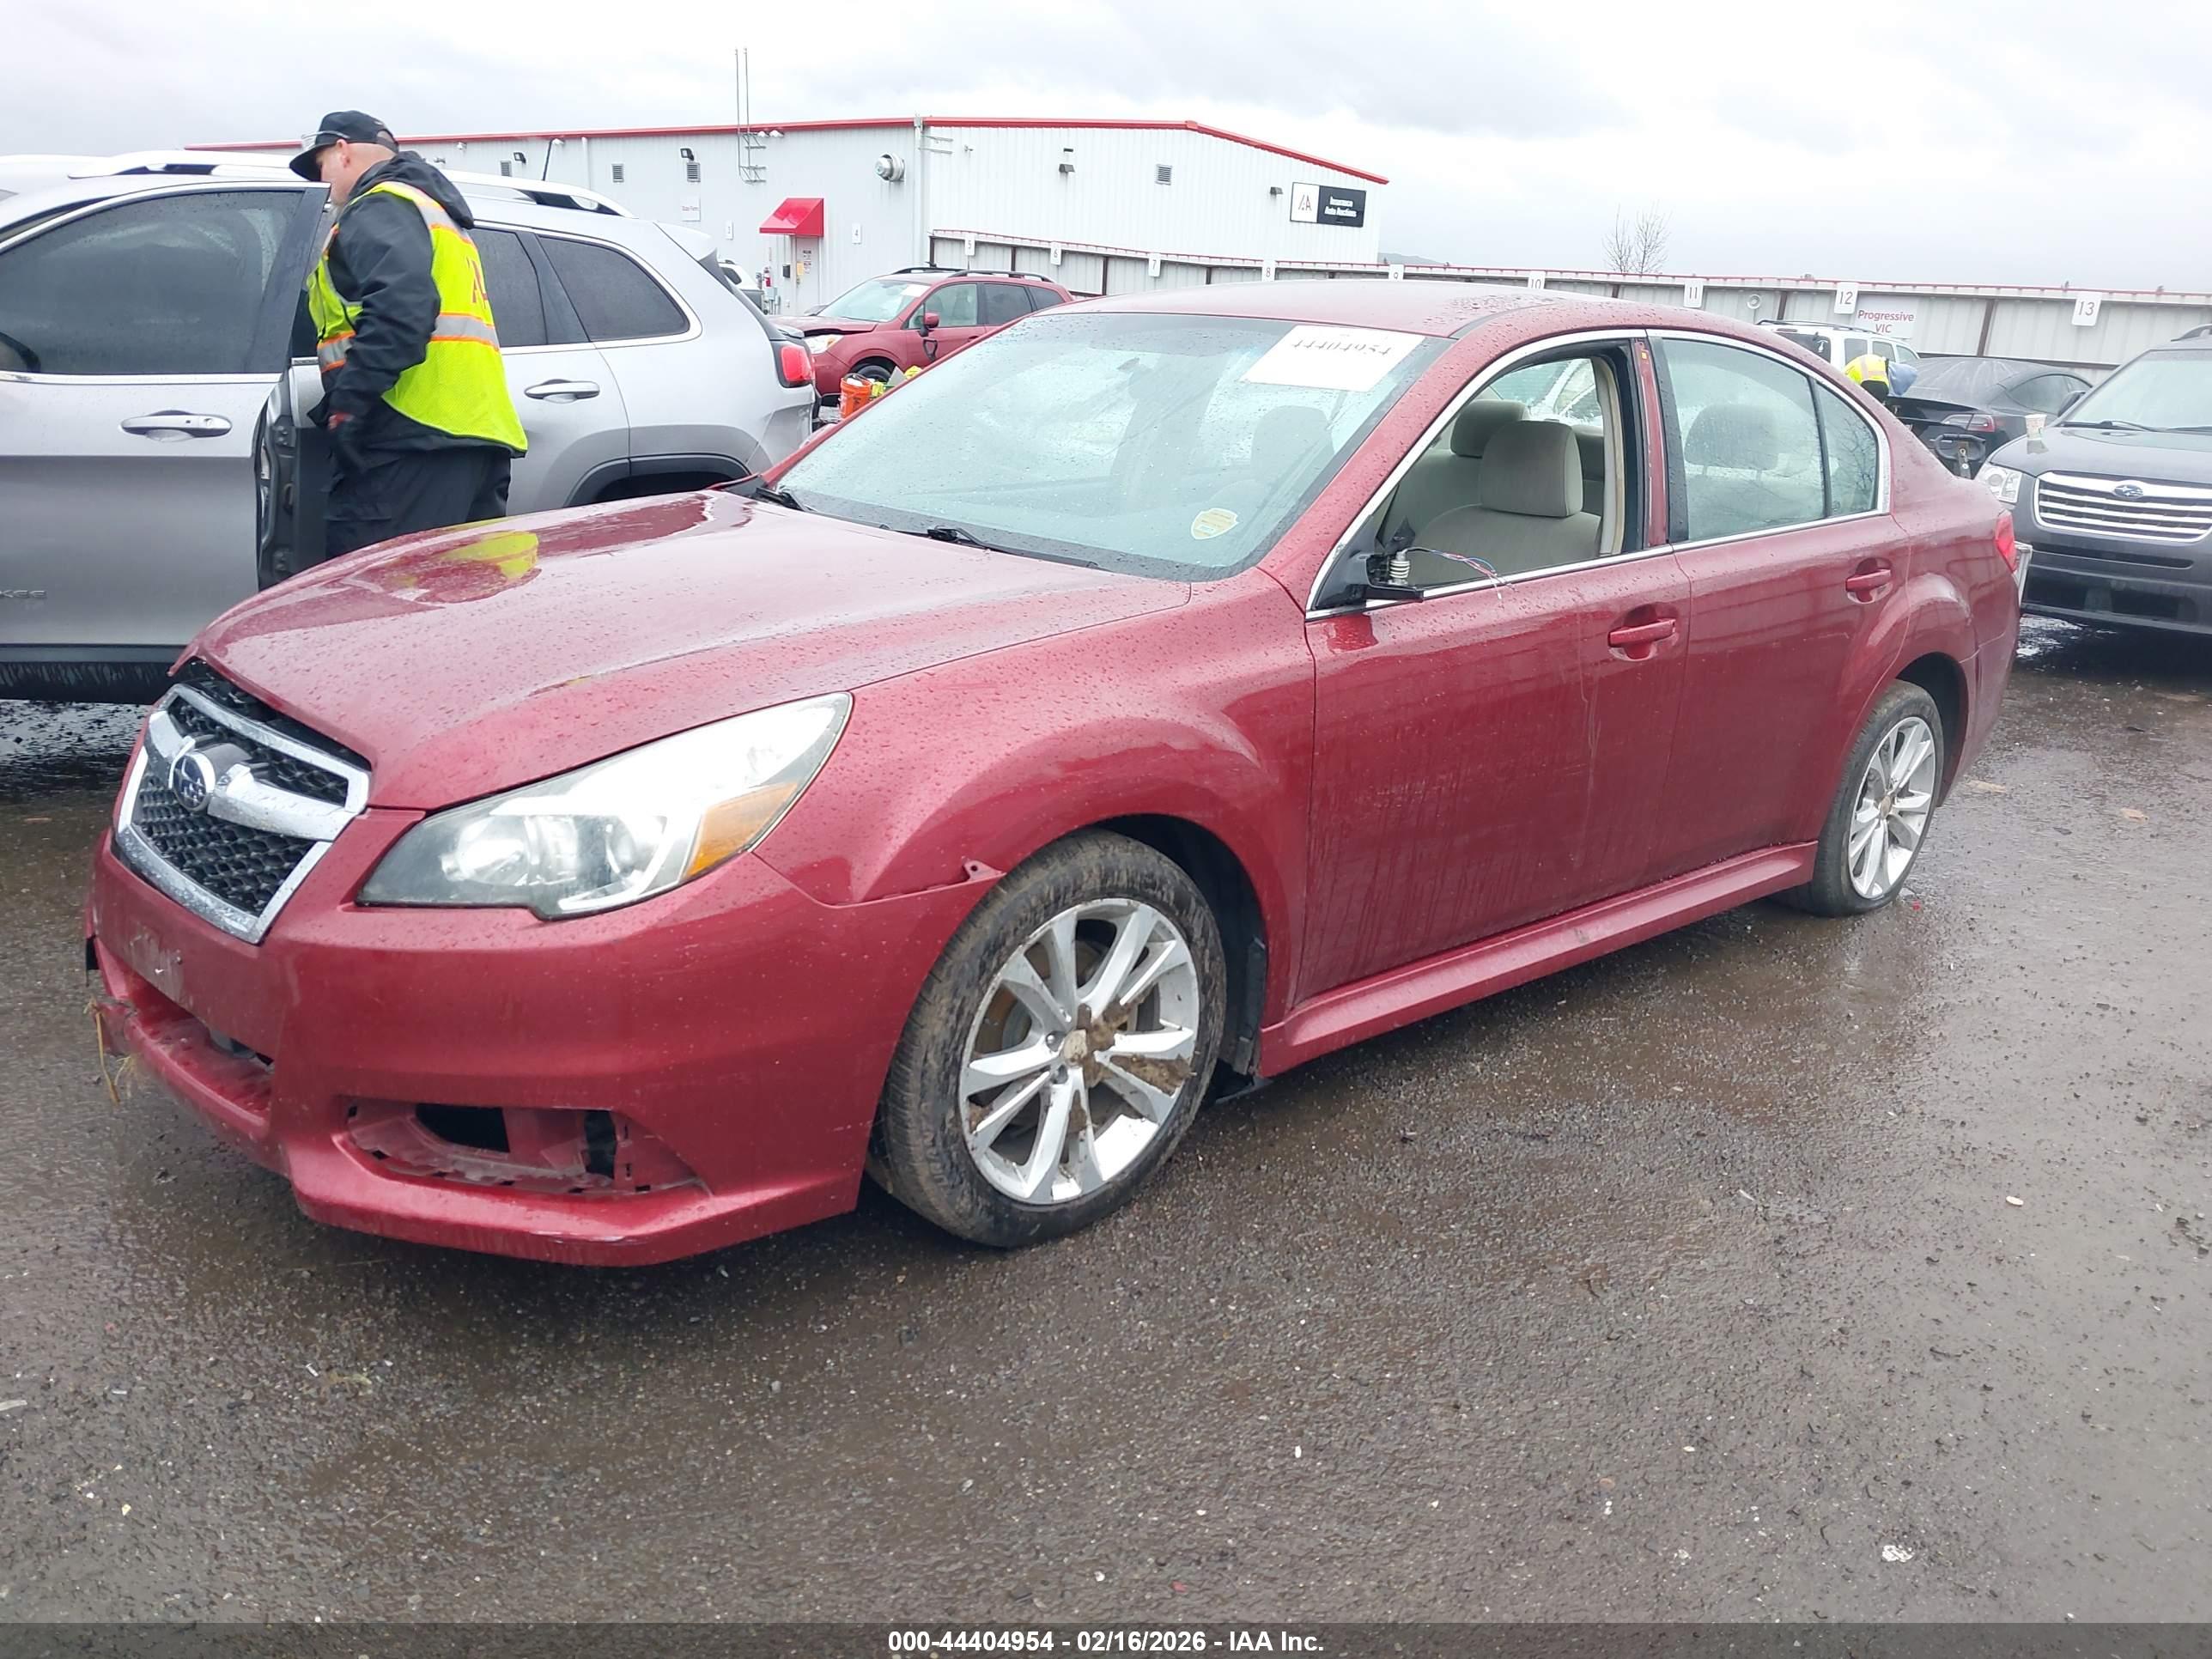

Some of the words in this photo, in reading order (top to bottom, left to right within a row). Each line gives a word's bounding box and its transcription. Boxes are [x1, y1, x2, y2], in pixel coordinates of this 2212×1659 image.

[967, 240, 973, 250] 5
[1053, 247, 1059, 258] 6
[1152, 258, 1158, 270] 7
[1266, 267, 1271, 277] 8
[1530, 278, 1542, 289] 10
[1688, 286, 1698, 301] 11
[1838, 290, 1852, 306] 12
[2078, 301, 2095, 317] 13
[1857, 309, 1915, 323] Progressive
[1875, 323, 1892, 333] VIC
